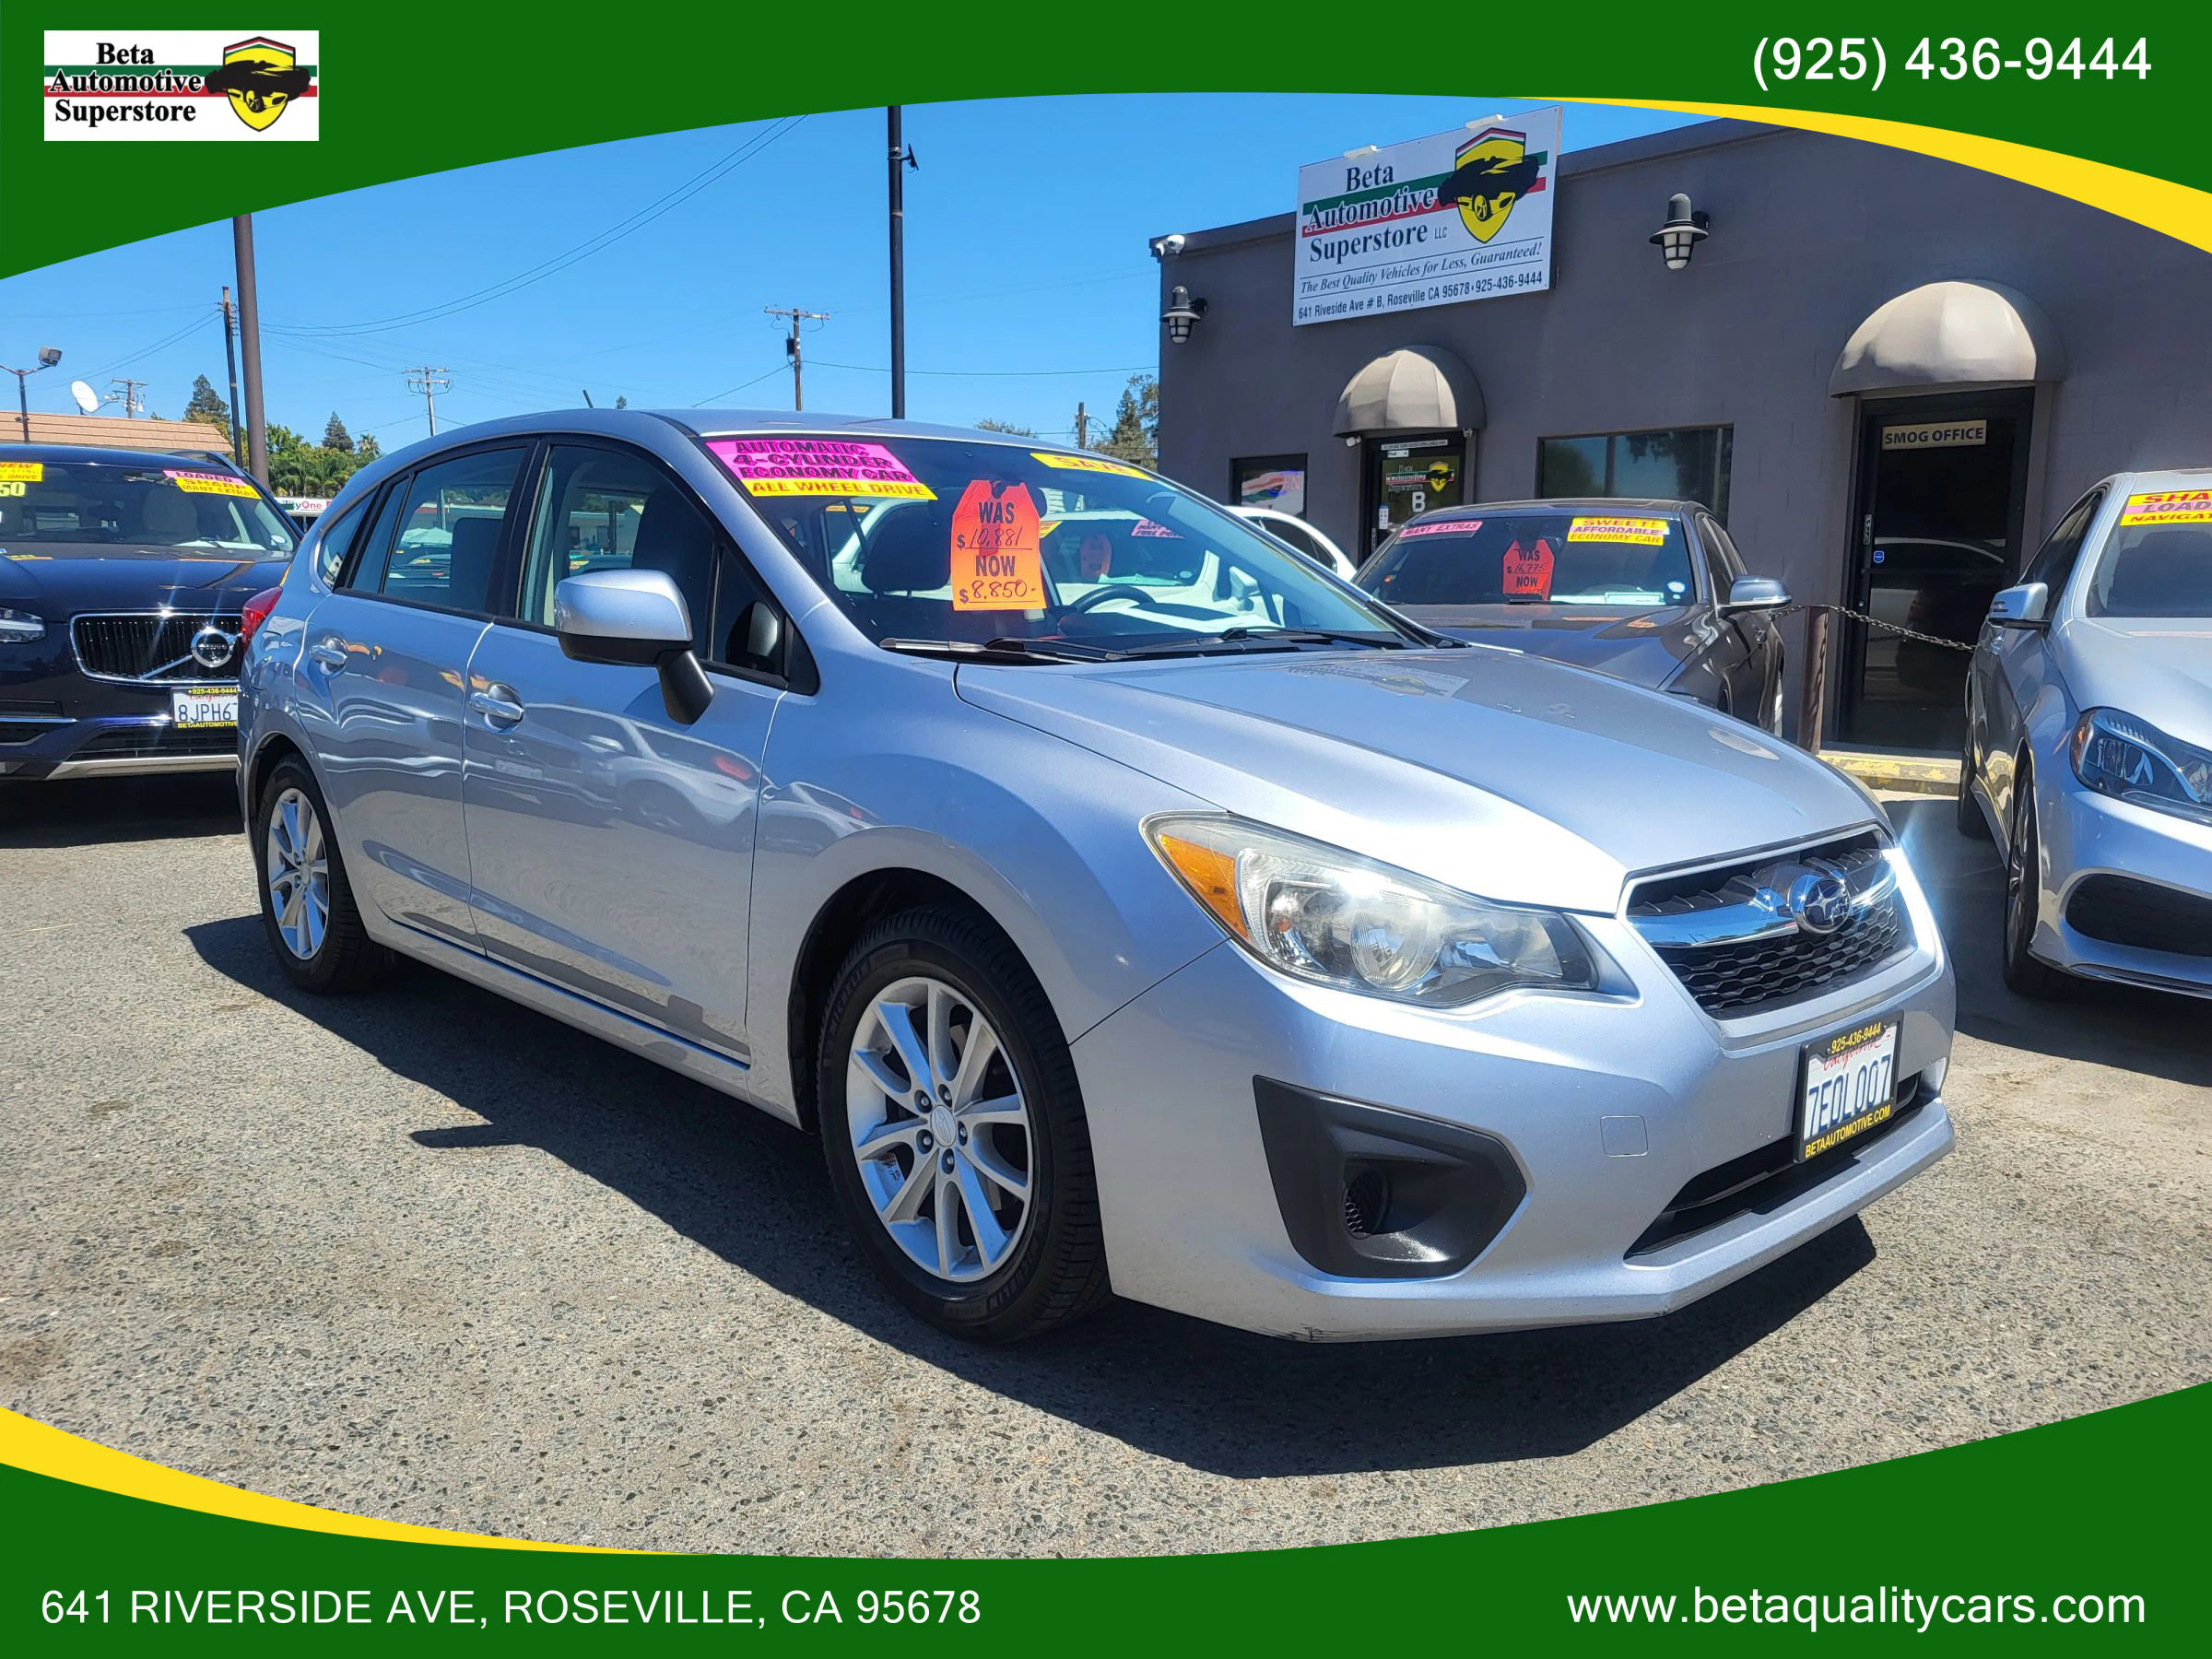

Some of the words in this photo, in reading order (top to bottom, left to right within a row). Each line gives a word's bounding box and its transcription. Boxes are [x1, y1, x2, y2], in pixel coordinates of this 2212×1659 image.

[1346, 164, 1394, 192] Beta
[1307, 187, 1434, 230] Automotive
[1310, 225, 1428, 264] Superstore
[1435, 228, 1447, 240] LLC
[1301, 281, 1317, 293] The
[1321, 278, 1340, 290] Best
[1343, 272, 1377, 288] Quality
[1381, 264, 1420, 280] Vehicles
[1422, 260, 1438, 276] for
[1441, 258, 1467, 271] Less,
[1471, 241, 1542, 266] Guaranteed!
[1299, 306, 1312, 319] 641
[1315, 301, 1347, 317] Riveside
[1349, 300, 1364, 312] Ave
[1387, 289, 1426, 307] Roseville
[1428, 287, 1440, 300] CA
[1885, 431, 1928, 444] SMOG
[1932, 427, 1984, 442] OFFICE
[735, 441, 869, 457] AUTOMATIC
[733, 453, 896, 470] 4-CYLINDER
[176, 472, 232, 483] LOADED
[739, 466, 859, 480] ECONOMY
[862, 469, 913, 483] CAR
[218, 488, 257, 497] EXTRAS
[752, 481, 790, 492] ALL
[798, 482, 864, 493] WHEEL
[871, 484, 927, 496] DRIVE
[1412, 491, 1426, 512] B
[978, 500, 1016, 524] WAS
[1438, 523, 1480, 531] EXTRAS
[1573, 526, 1660, 535] AFFORDABLE
[1570, 533, 1630, 541] ECONOMY
[975, 555, 1016, 577] NOW
[1517, 576, 1538, 587] NOW
[178, 703, 238, 722] 8JPH6
[1830, 1021, 1882, 1055] 925-436-9444
[1805, 1104, 1891, 1159] BETAAUTOMOTIVE.COM
